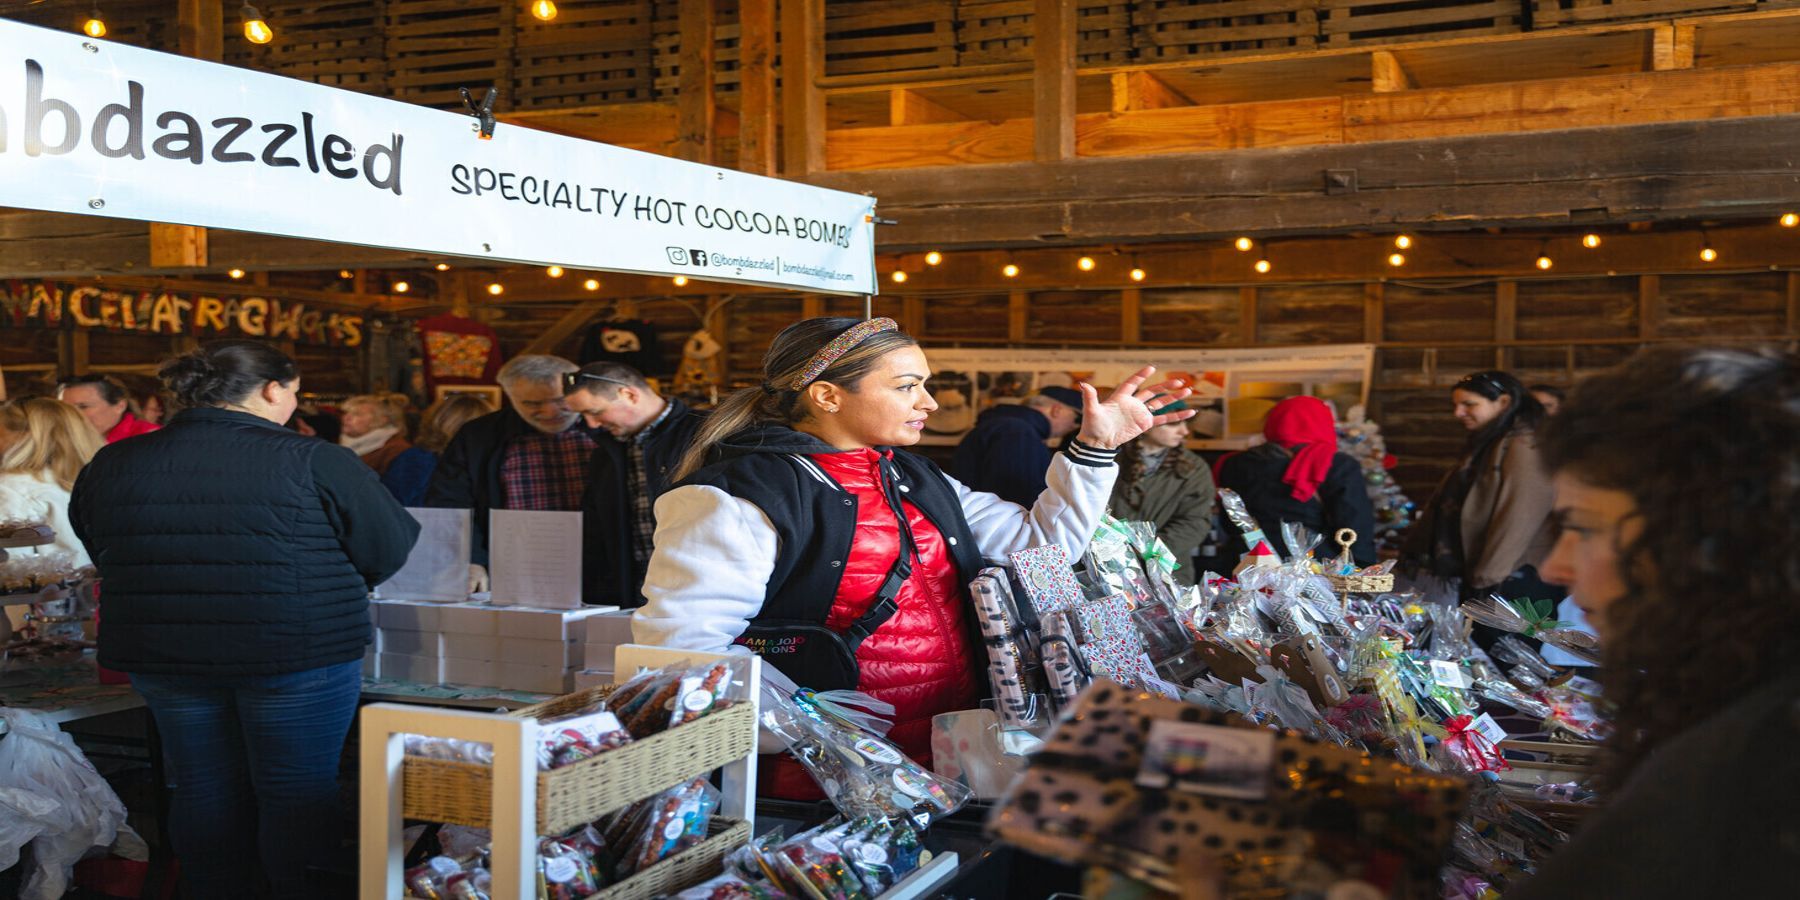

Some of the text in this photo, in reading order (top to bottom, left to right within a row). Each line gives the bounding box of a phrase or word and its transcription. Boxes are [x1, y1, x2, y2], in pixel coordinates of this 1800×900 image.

[0, 59, 404, 196] bdazzled
[451, 164, 852, 249] SPECIALTY HOT COCOA BOMBS
[711, 252, 775, 271] @bombdazzled
[777, 635, 806, 647] JOJO
